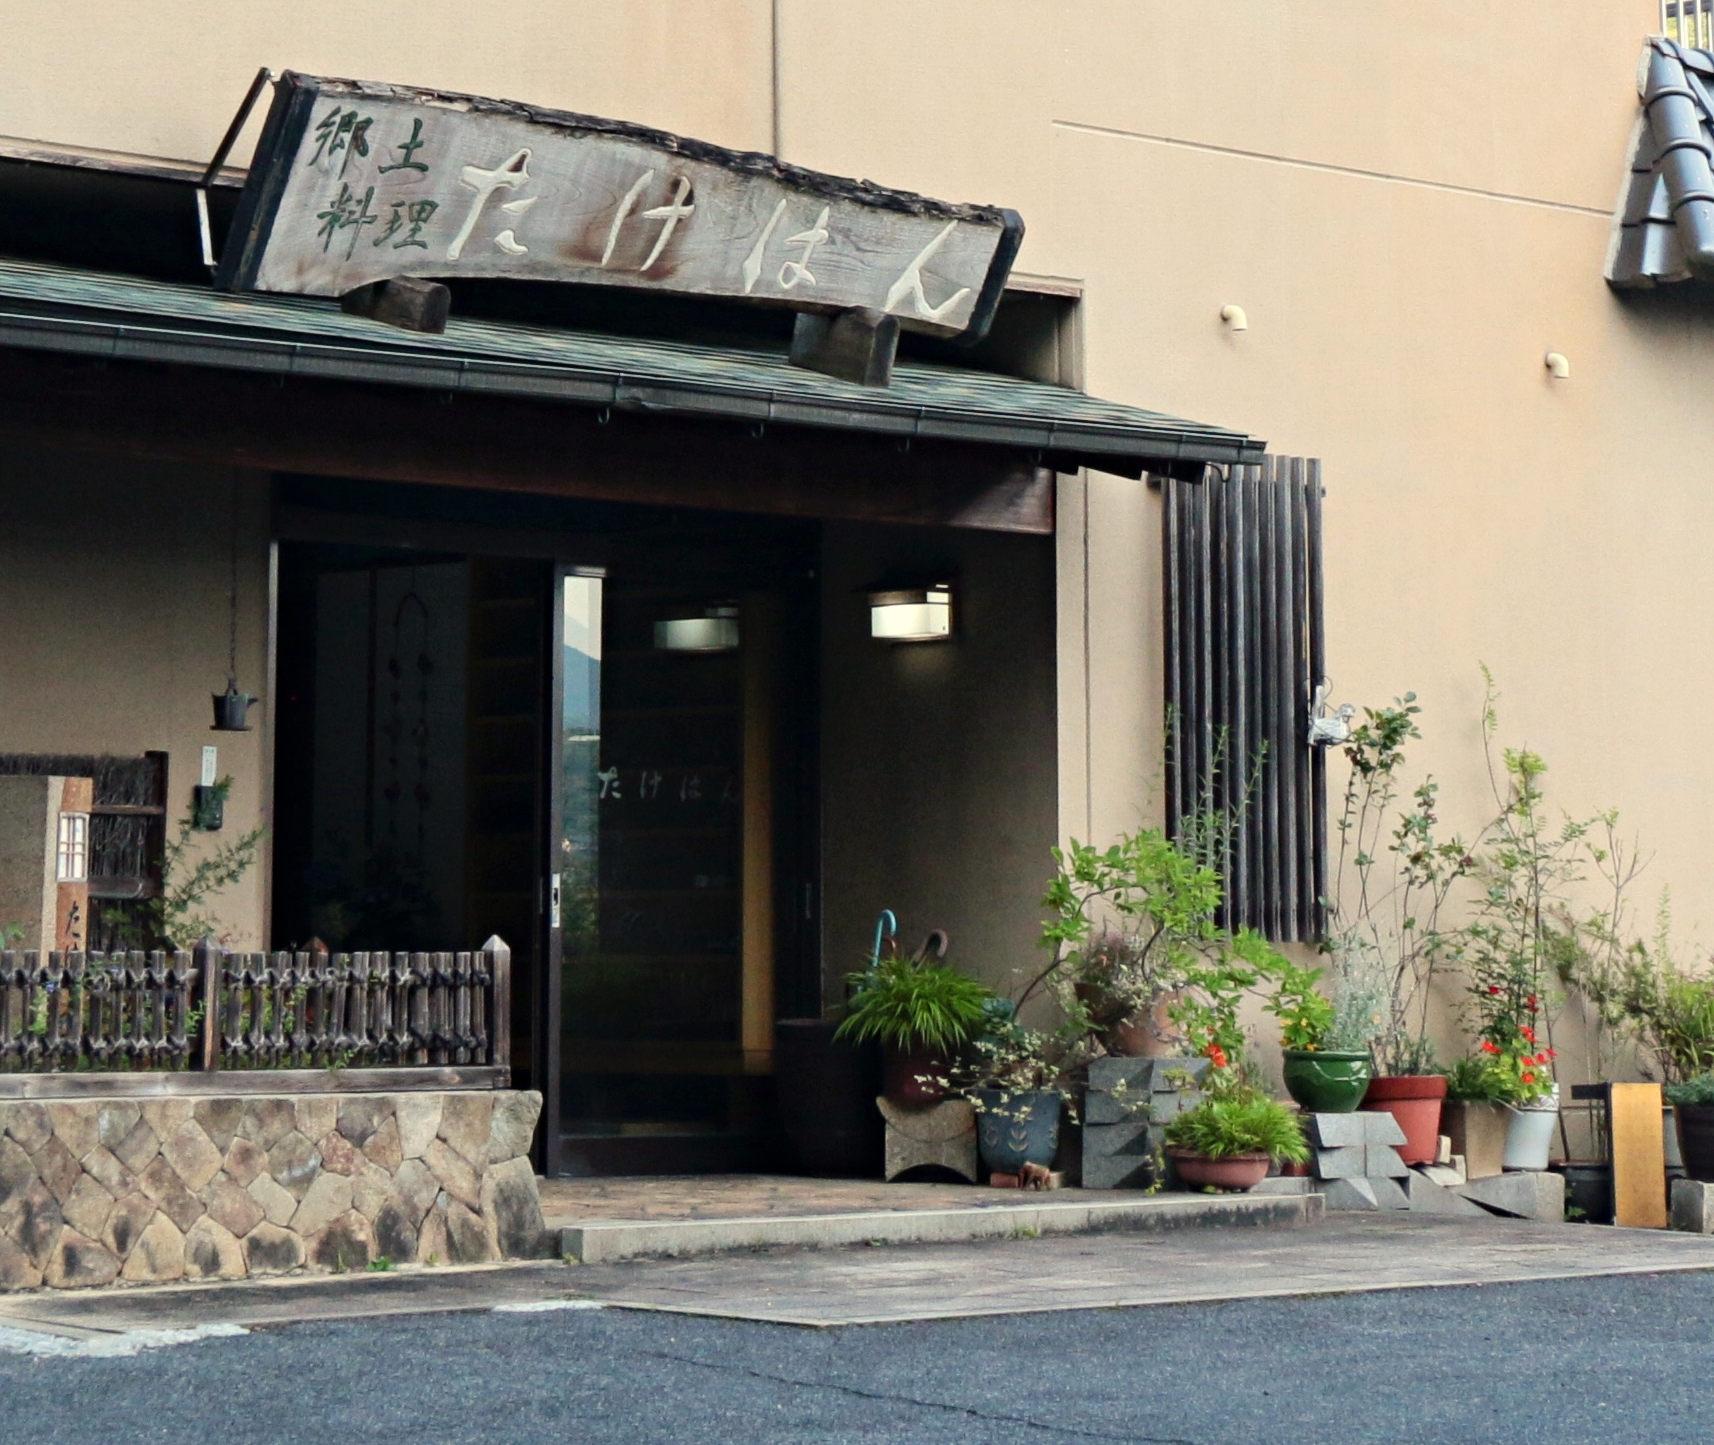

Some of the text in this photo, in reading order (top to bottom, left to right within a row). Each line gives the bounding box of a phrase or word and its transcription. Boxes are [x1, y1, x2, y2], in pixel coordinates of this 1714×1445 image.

[309, 106, 429, 180] 郷土
[317, 182, 439, 262] 料理
[445, 149, 970, 319] たけはん
